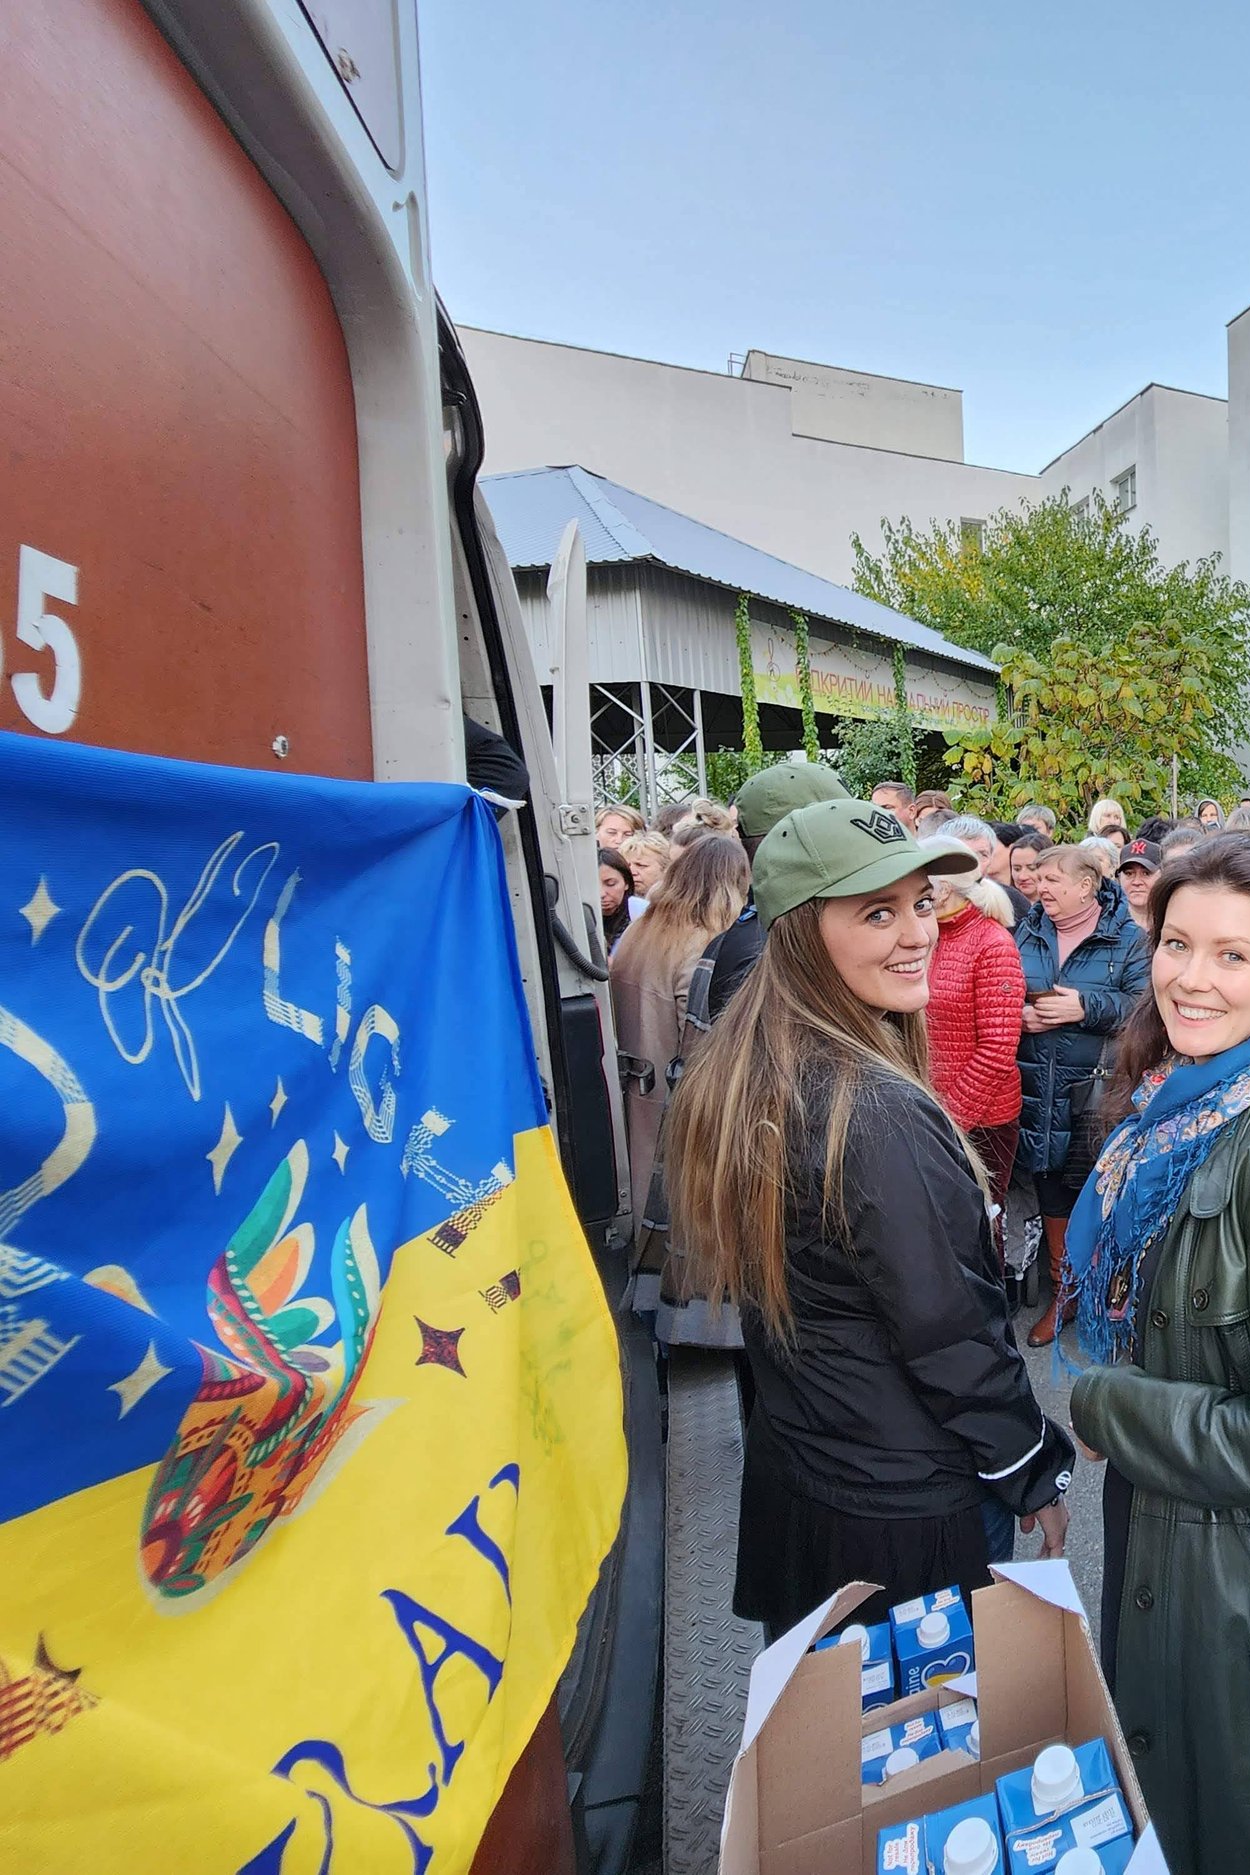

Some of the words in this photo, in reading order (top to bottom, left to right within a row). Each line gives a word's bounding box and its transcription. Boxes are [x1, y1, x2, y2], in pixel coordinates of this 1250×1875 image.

[0, 543, 82, 734] 5
[795, 665, 873, 703] ДКРИТИЙ
[1131, 841, 1147, 854] NY
